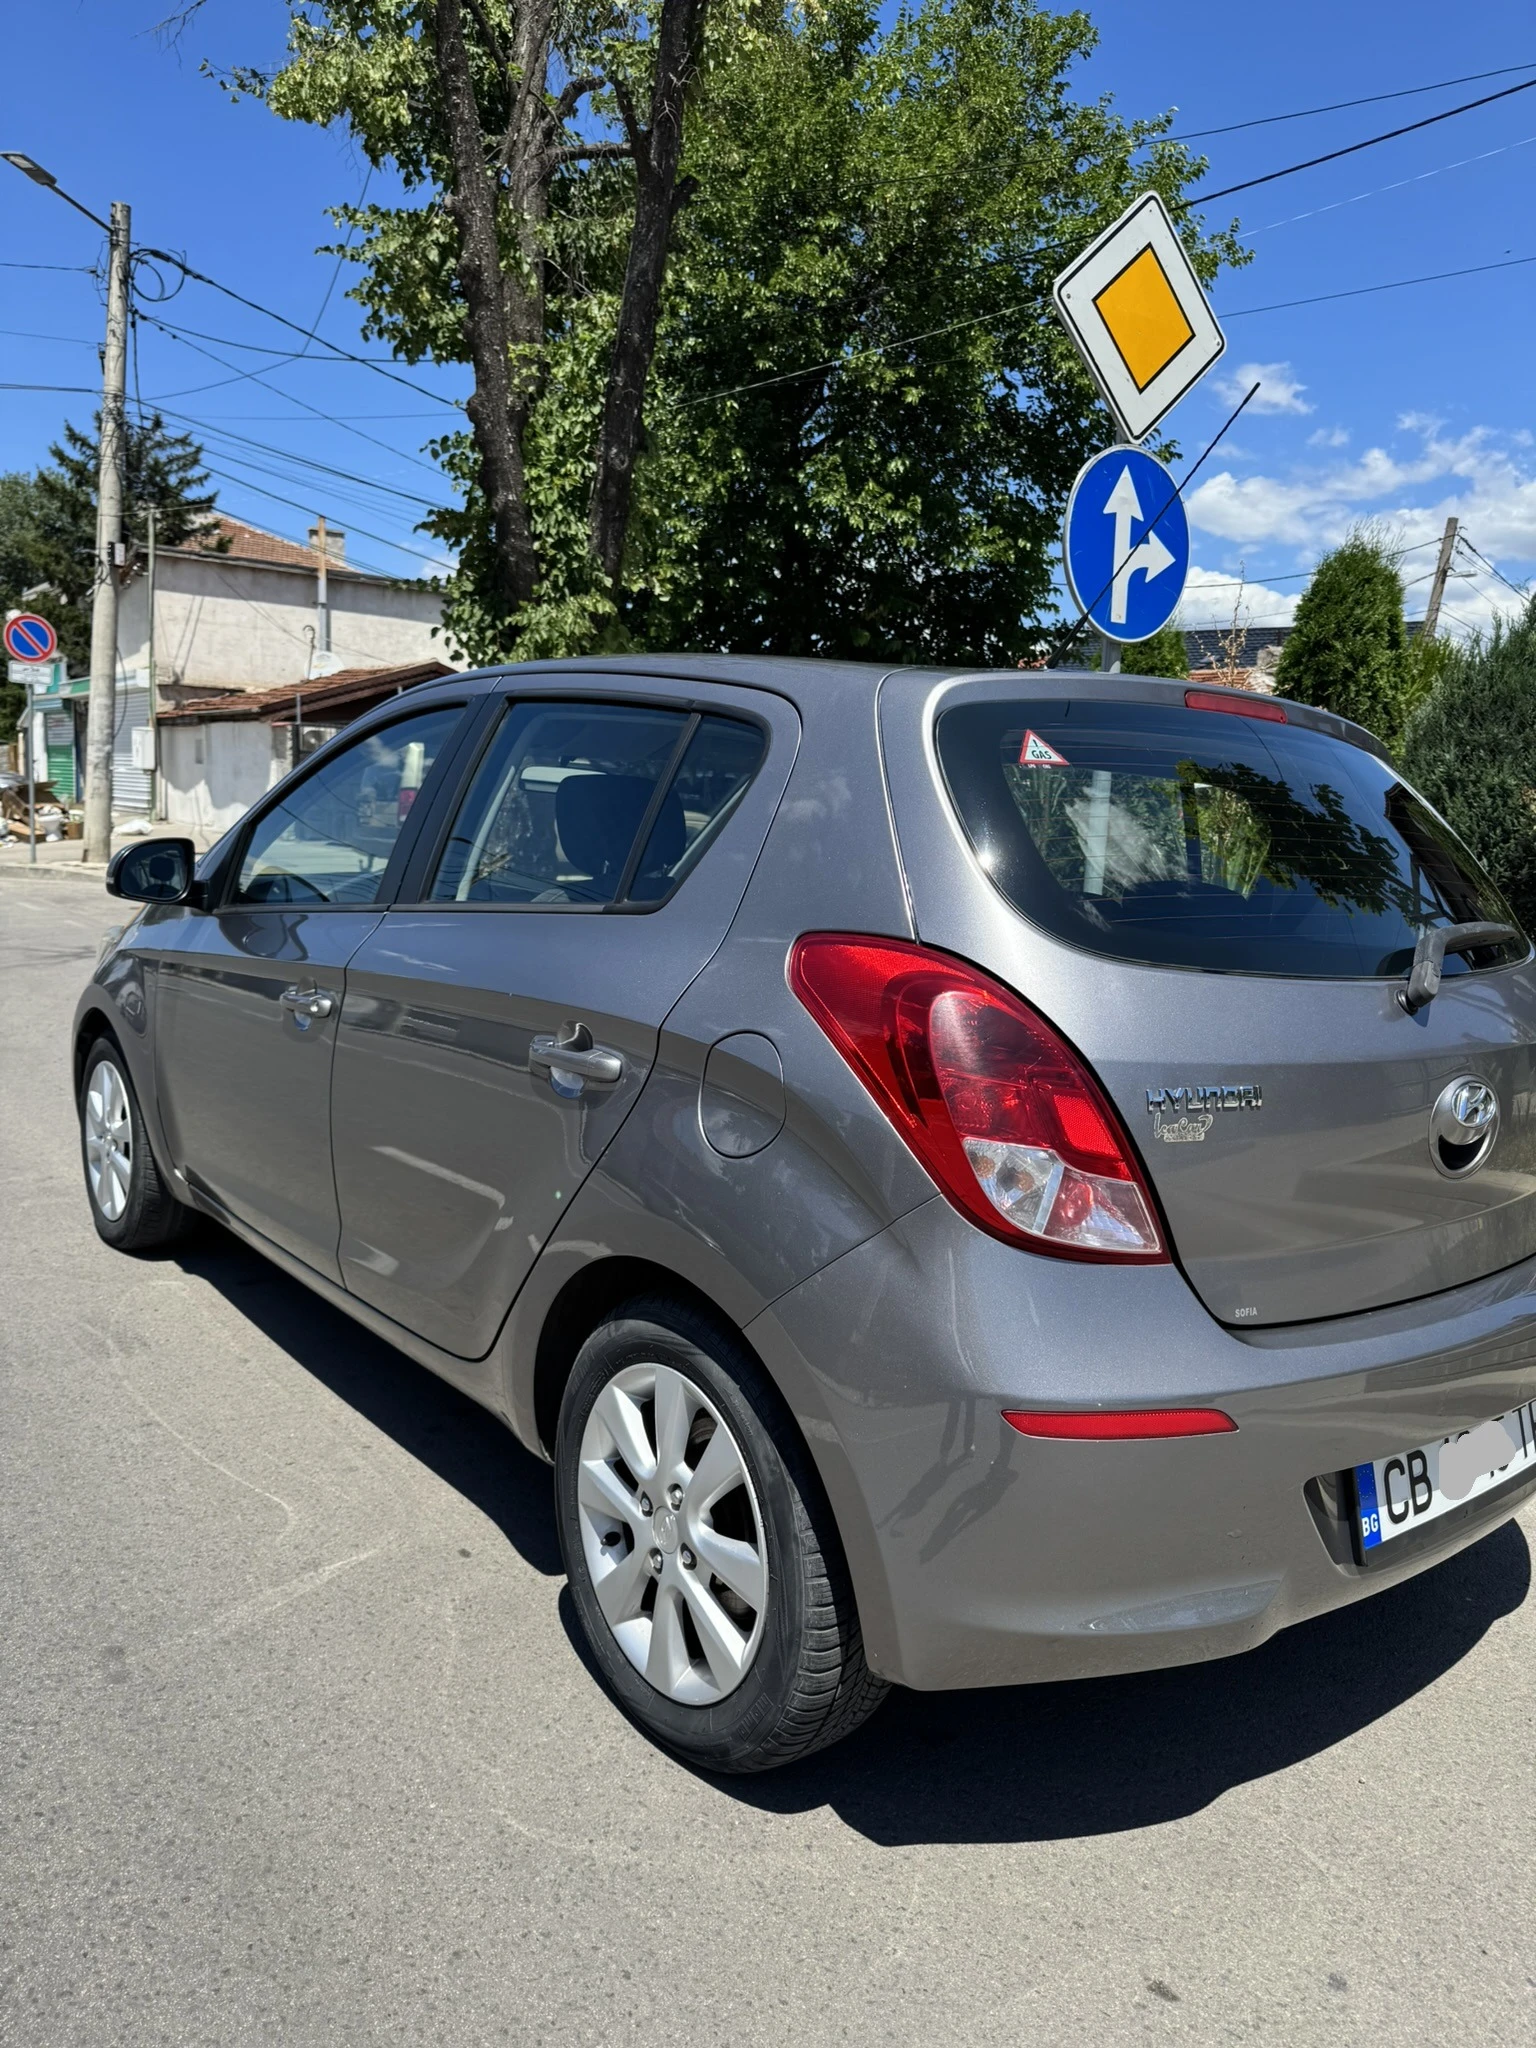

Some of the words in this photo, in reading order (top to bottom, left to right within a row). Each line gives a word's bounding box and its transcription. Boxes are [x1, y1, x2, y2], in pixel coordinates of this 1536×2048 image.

[1031, 750, 1052, 759] GAS
[1146, 1085, 1262, 1113] HYUNDAI
[1235, 1306, 1258, 1318] SOFIA
[1384, 1450, 1433, 1525] CB
[1361, 1513, 1379, 1537] BG
